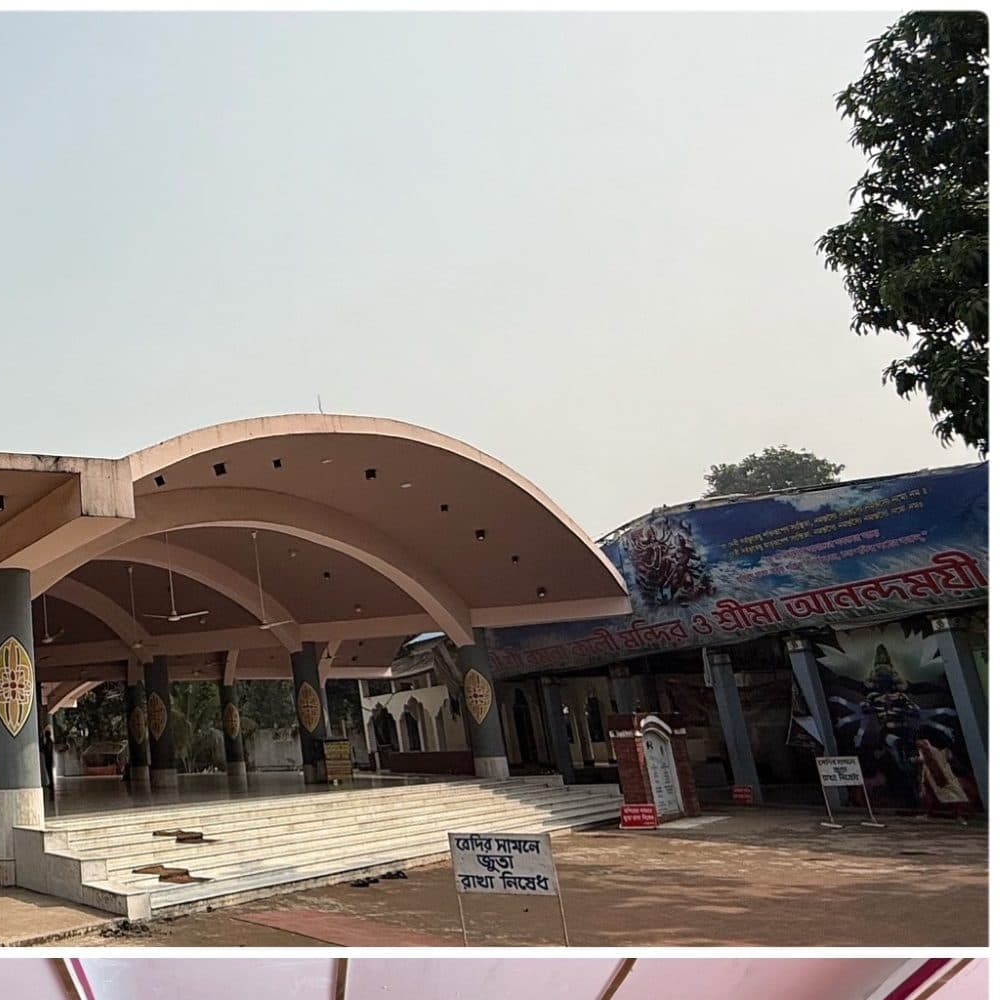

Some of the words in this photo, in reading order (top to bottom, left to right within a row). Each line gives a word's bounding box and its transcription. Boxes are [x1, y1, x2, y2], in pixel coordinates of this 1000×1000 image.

[617, 619, 689, 650] মন্দির
[691, 614, 713, 636] ও
[711, 599, 782, 633] শ্রীমা
[780, 550, 988, 620] আনন্দময়ী
[455, 833, 492, 853] বেদির
[495, 838, 541, 854] সামনে
[476, 854, 514, 872] জুতা
[458, 874, 495, 890] রাখা
[498, 871, 550, 891] নিষেধ
